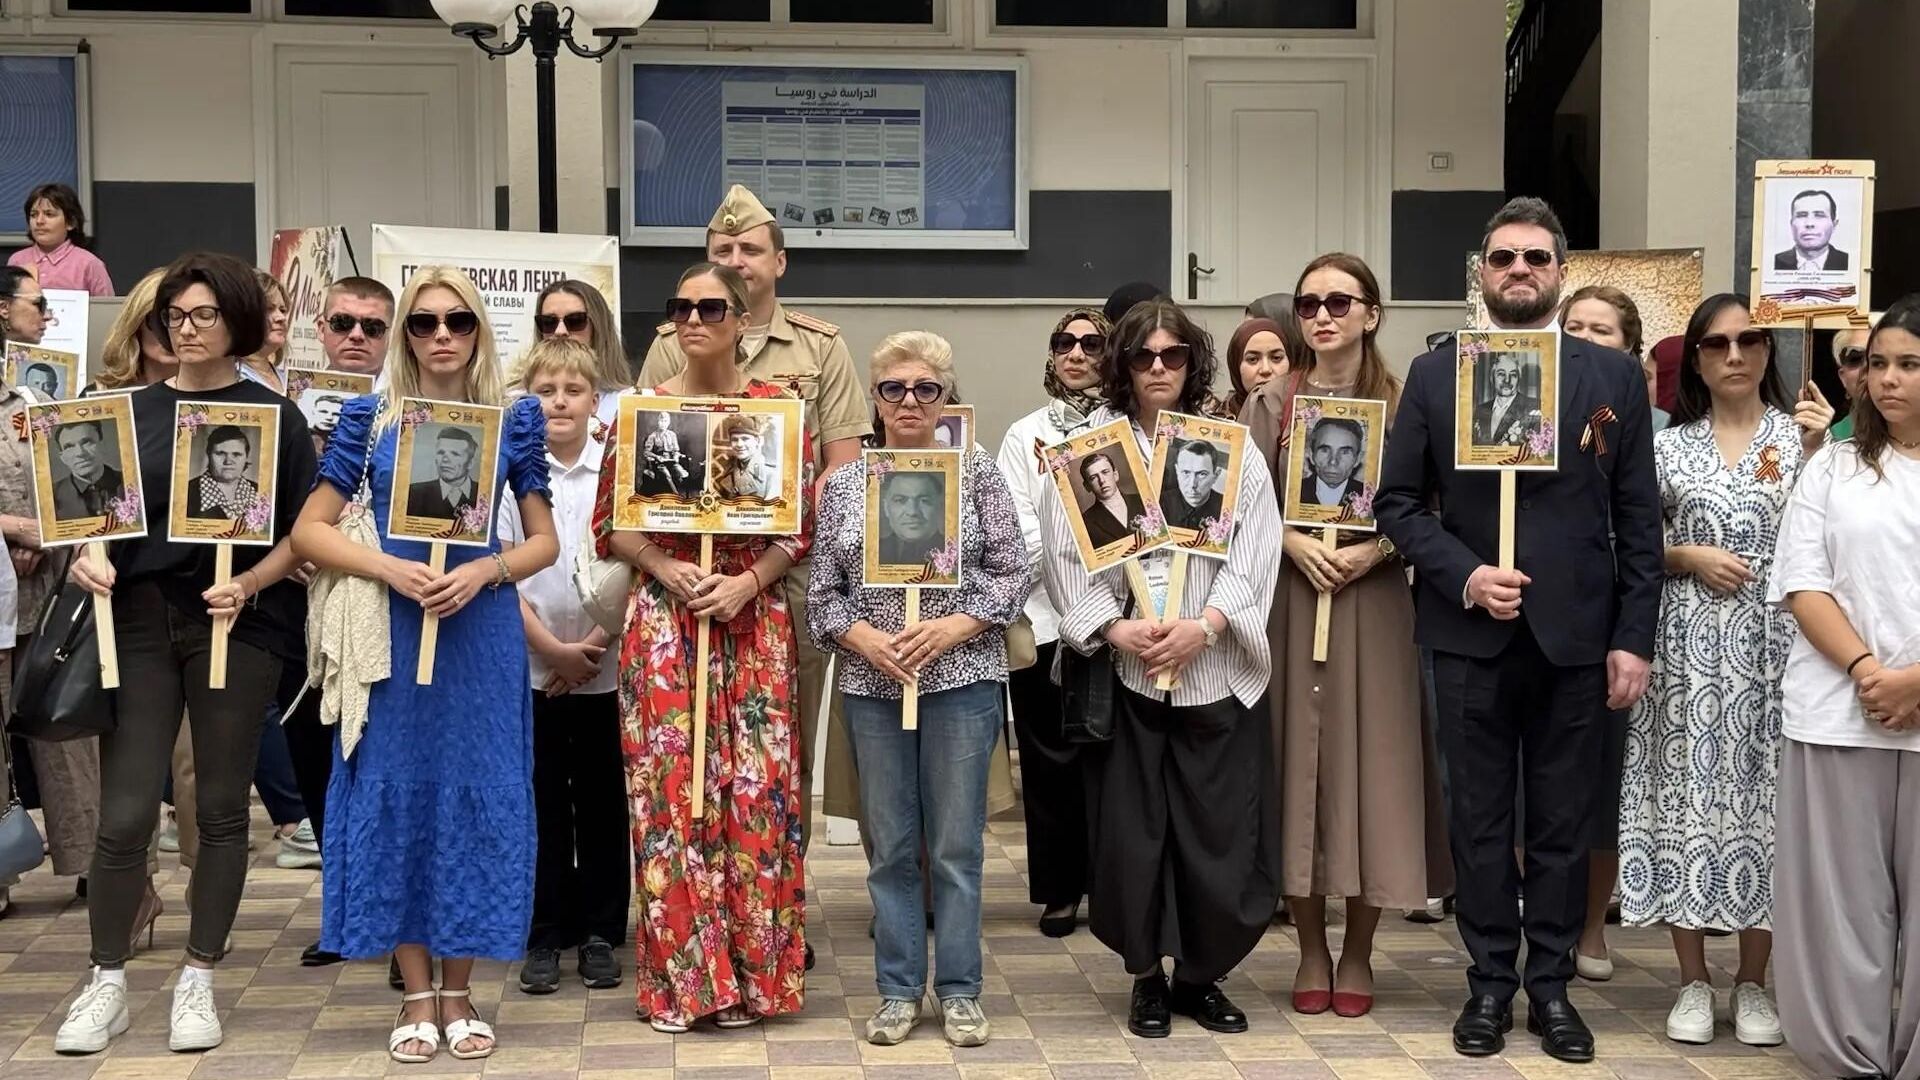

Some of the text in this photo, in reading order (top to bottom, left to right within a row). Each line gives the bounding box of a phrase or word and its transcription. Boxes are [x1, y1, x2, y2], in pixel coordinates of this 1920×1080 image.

[819, 88, 838, 100] في
[401, 264, 517, 292] ГВСКАЯ
[493, 296, 525, 308] СЛАВЫ
